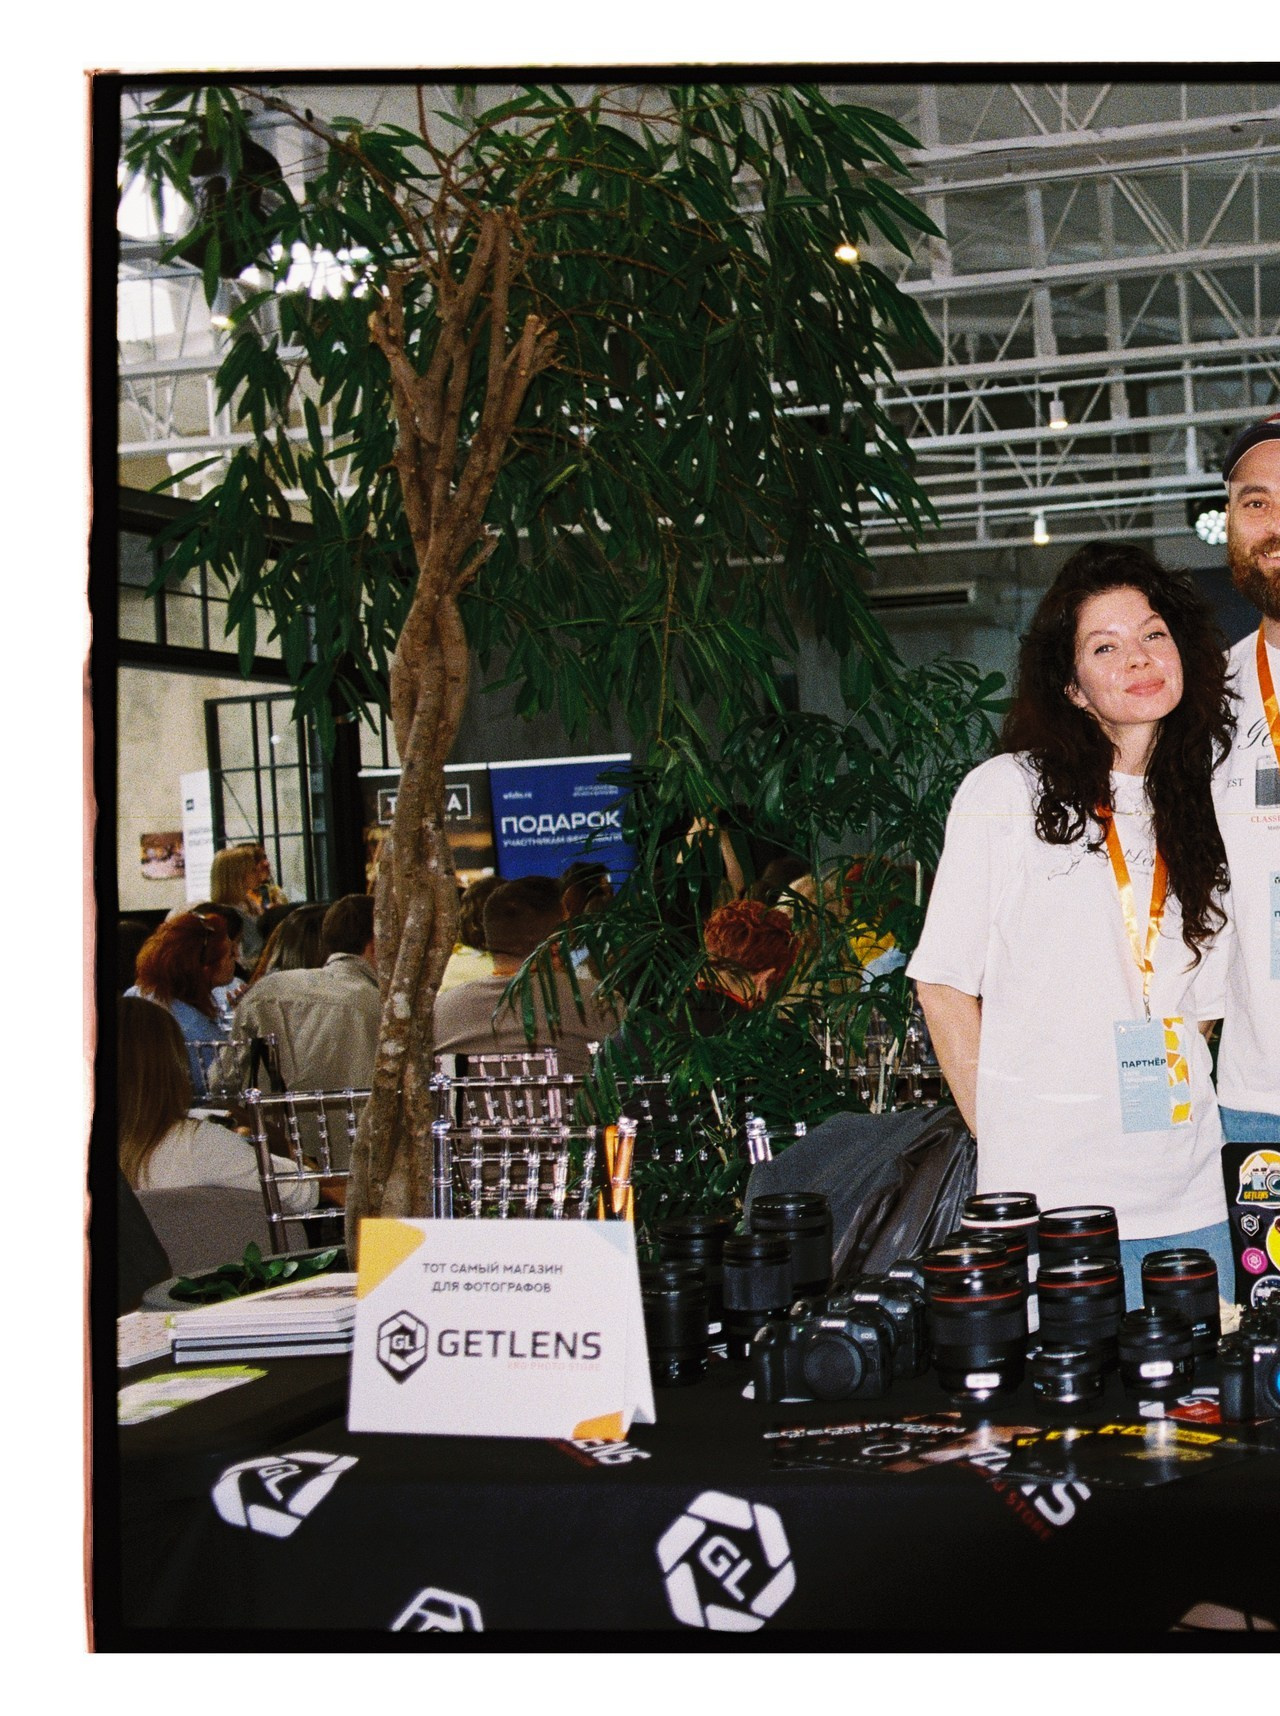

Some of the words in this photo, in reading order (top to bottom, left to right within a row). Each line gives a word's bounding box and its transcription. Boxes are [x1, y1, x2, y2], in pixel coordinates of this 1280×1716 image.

[501, 811, 621, 835] ПОДАРОК
[1121, 1057, 1167, 1069] ПАРТНЁР
[1243, 1190, 1269, 1201] GETLENS
[422, 1262, 447, 1274] ТОТ
[450, 1261, 500, 1275] САМЫЙ
[503, 1264, 564, 1275] МАГАЗИН
[431, 1282, 460, 1293] ДЛЯ
[463, 1282, 552, 1293] ФОТОГРАФОВ
[854, 1294, 880, 1302] Canon
[820, 1320, 847, 1328] Canon
[437, 1329, 602, 1360] GETLENS
[1253, 1346, 1277, 1354] SONY
[257, 1464, 303, 1502] GL
[699, 1535, 753, 1602] GL
